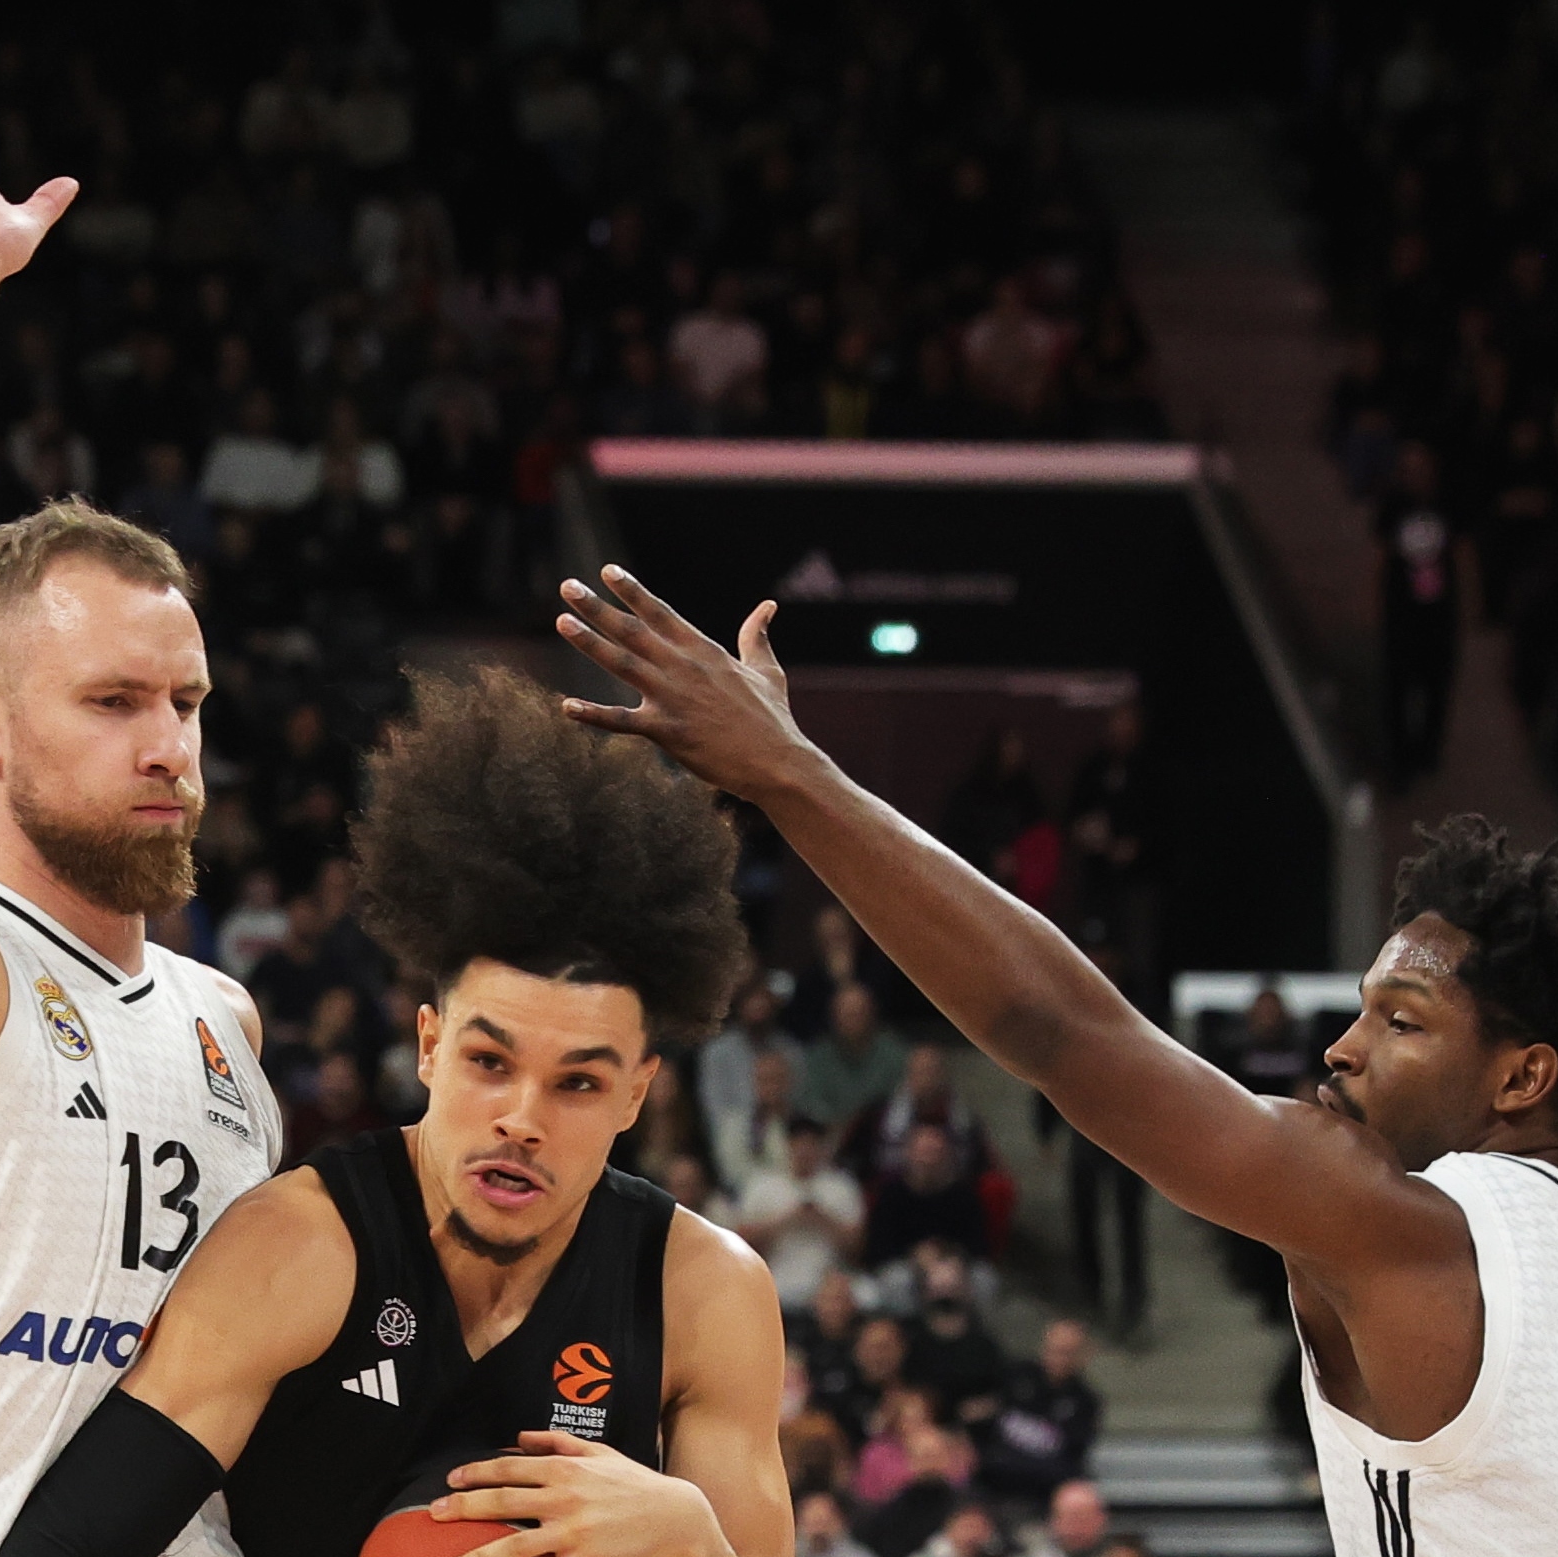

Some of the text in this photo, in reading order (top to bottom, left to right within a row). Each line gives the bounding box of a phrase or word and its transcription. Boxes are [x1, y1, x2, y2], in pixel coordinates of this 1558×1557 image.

[120, 1131, 200, 1274] 13
[552, 1402, 607, 1418] TURKISH
[550, 1413, 605, 1429] AIRLINES
